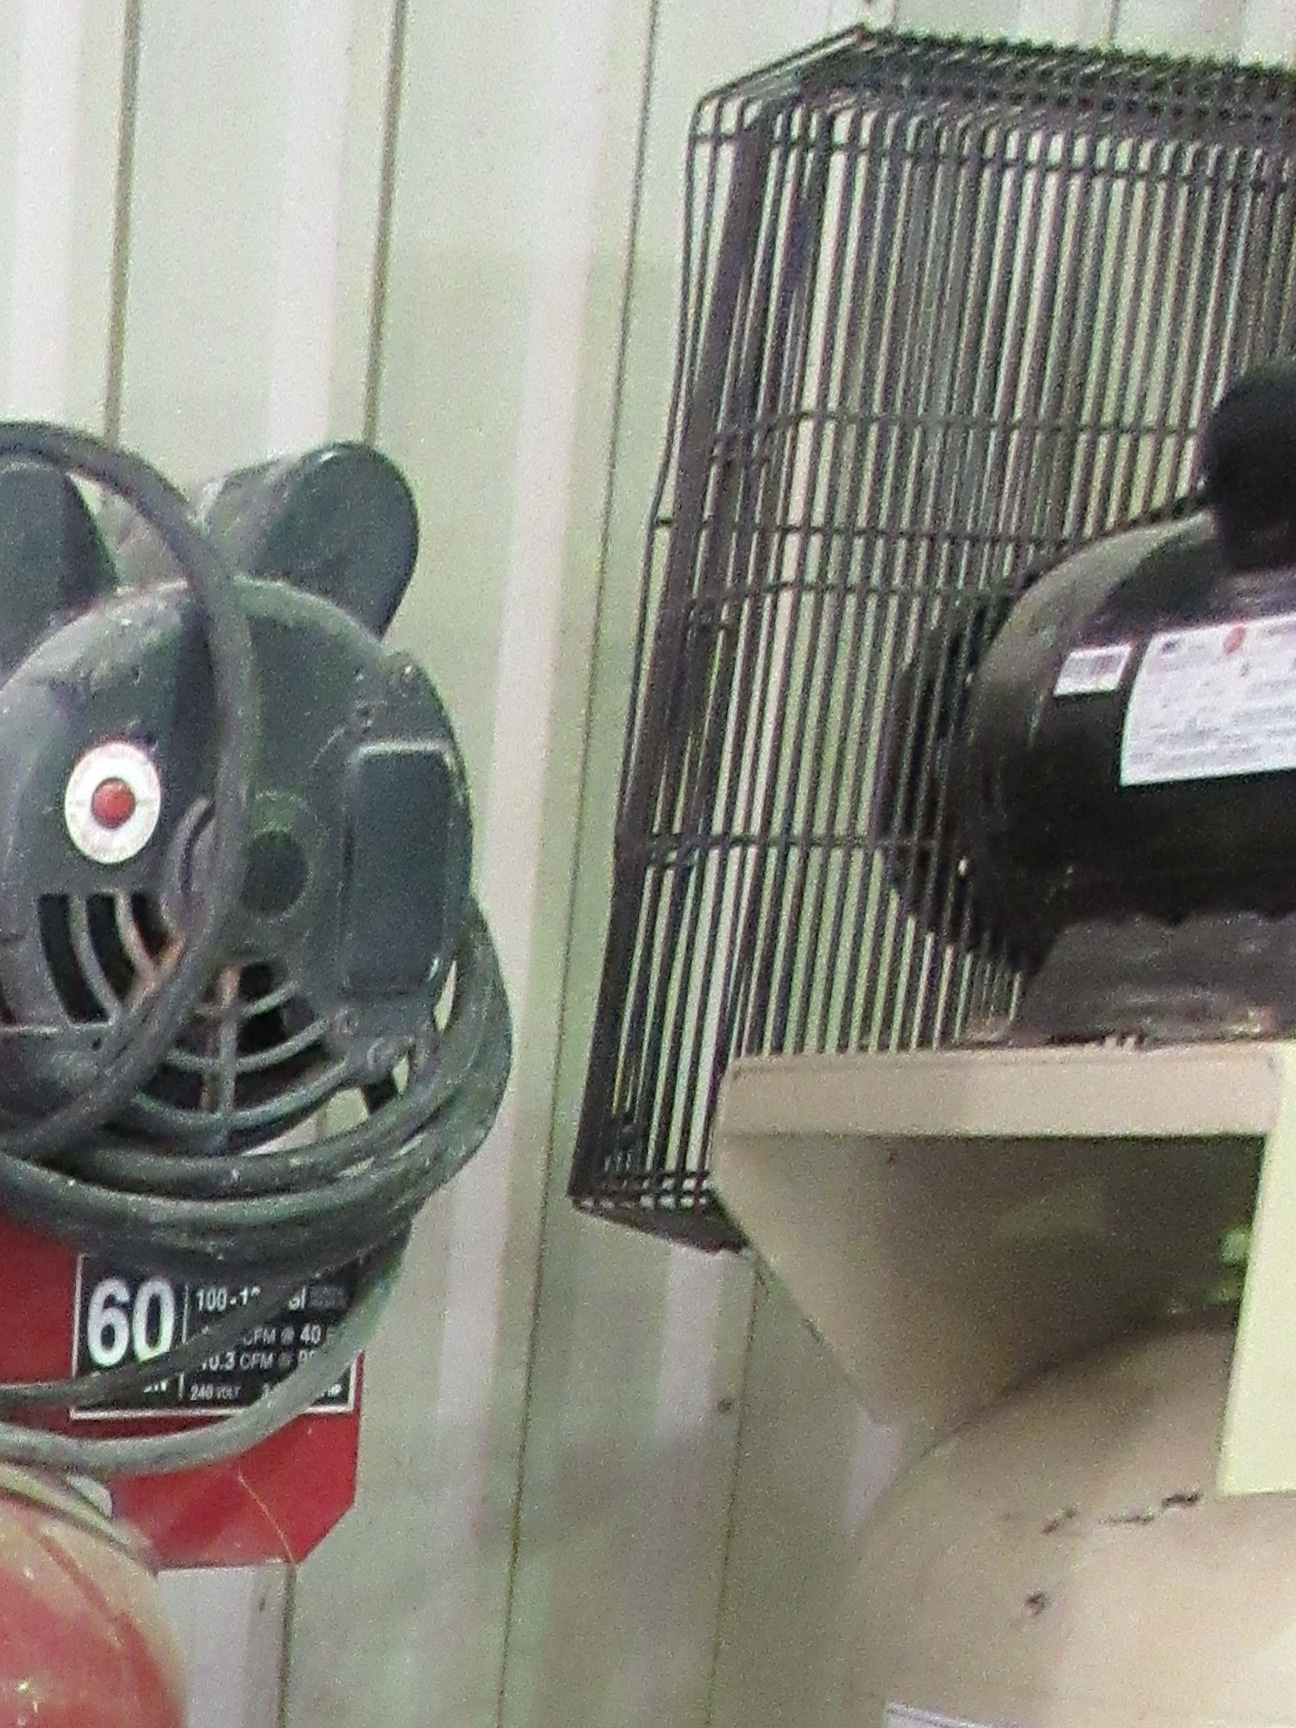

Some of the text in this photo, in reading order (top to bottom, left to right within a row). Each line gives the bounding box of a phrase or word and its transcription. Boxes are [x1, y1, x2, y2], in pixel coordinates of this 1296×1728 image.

[87, 1275, 176, 1368] 60
[299, 1323, 322, 1344] 40
[239, 1351, 273, 1370] CFM
